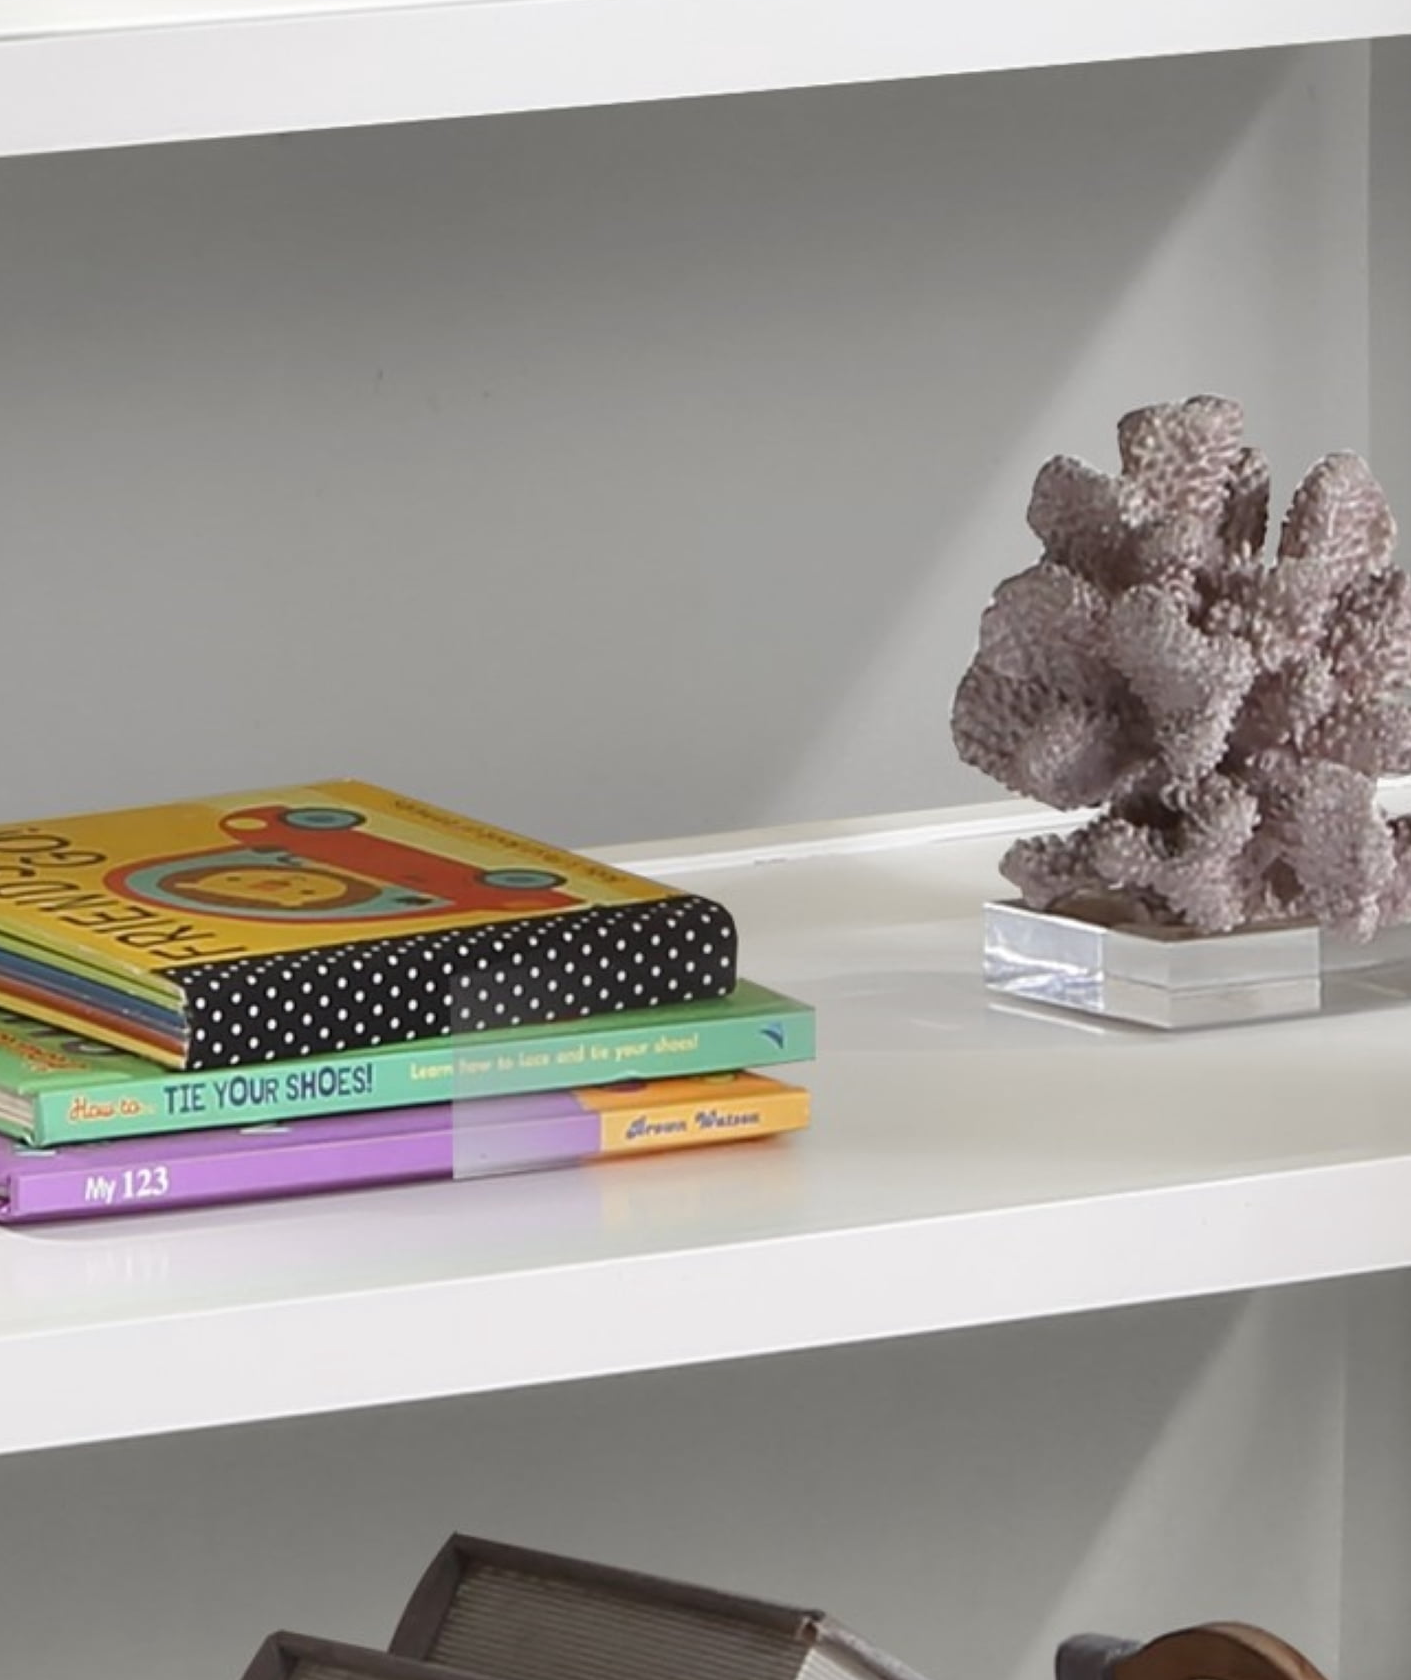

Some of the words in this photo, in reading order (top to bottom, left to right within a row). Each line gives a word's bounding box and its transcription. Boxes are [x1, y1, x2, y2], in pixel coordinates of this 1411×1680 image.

[409, 1061, 454, 1081] Learn
[458, 1058, 491, 1075] how
[497, 1054, 514, 1071] to
[556, 1045, 585, 1064] and
[590, 1044, 609, 1061] tie
[614, 1042, 648, 1062] your
[653, 1032, 699, 1055] shoes!
[68, 1095, 115, 1122] How
[164, 1082, 206, 1114] TIE
[213, 1075, 280, 1108] YOUR
[286, 1062, 374, 1101] SHOES!
[84, 1176, 116, 1204] My
[121, 1166, 170, 1199] 123
